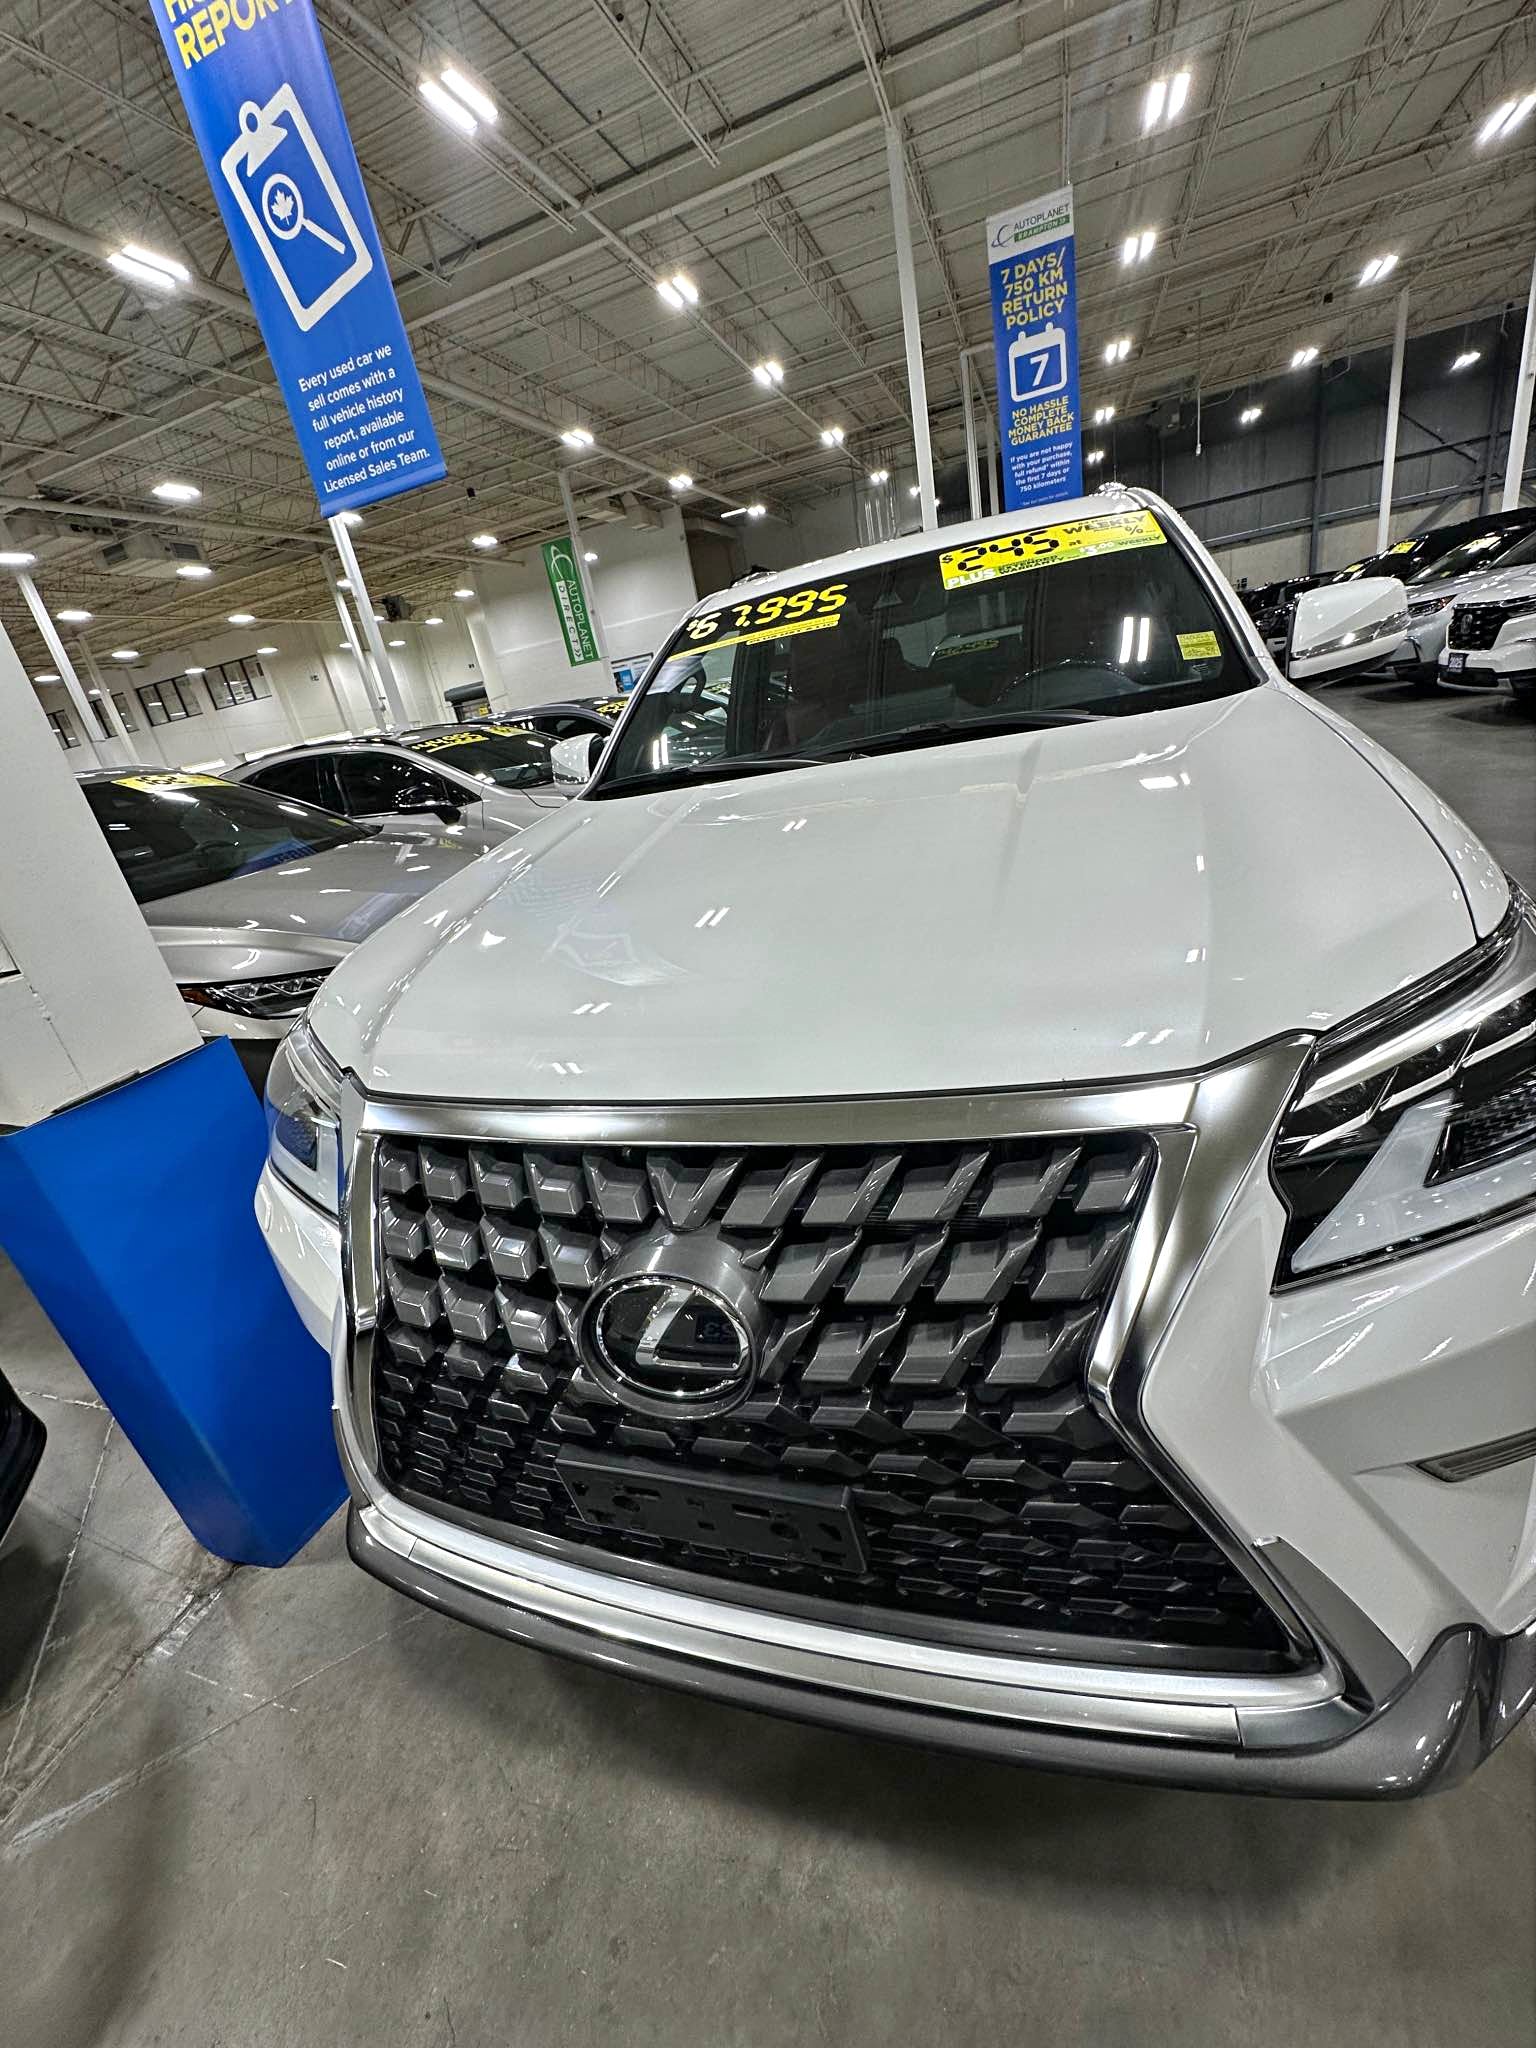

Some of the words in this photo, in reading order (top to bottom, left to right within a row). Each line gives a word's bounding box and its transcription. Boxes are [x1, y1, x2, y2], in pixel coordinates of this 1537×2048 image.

[1014, 202, 1070, 230] AUTOPLANET
[1000, 268, 1010, 284] 7
[1014, 246, 1066, 280] DAYS/
[1001, 281, 1068, 316] RETURN
[1004, 277, 1034, 299] 750
[1038, 266, 1063, 287] KM
[1006, 298, 1065, 330] POLICY
[298, 371, 327, 392] Every
[329, 357, 355, 380] used
[356, 352, 373, 367] car
[375, 344, 392, 360] we
[1030, 353, 1049, 387] 7
[308, 394, 327, 412] sell
[327, 382, 362, 404] comes
[361, 371, 387, 389] with
[388, 367, 396, 379] a
[312, 413, 330, 432] full
[330, 402, 366, 425] vehicle
[366, 388, 404, 411] history
[1012, 407, 1027, 420] NO
[1030, 395, 1069, 413] HASSLE
[1014, 405, 1068, 428] COMPLETE
[323, 428, 359, 450] report,
[360, 410, 405, 437] available
[1008, 420, 1046, 439] MONEY
[1046, 411, 1075, 428] BACK
[1011, 423, 1073, 446] GUARANTEE
[326, 450, 357, 471] online
[358, 446, 370, 459] or
[370, 436, 397, 455] from
[398, 429, 415, 444] our
[1012, 461, 1026, 471] with
[1026, 458, 1041, 469] your
[1016, 453, 1029, 464] you
[1029, 450, 1040, 459] are
[1040, 446, 1052, 456] not
[1053, 441, 1073, 453] happy
[323, 468, 367, 493] Licensed
[368, 457, 397, 477] Sales
[398, 447, 431, 466] Team.
[1014, 468, 1025, 478] full
[1050, 458, 1070, 470] within
[1015, 476, 1026, 487] the
[1027, 474, 1040, 483] first
[1062, 466, 1071, 474] or
[1020, 484, 1032, 493] 750
[1033, 476, 1067, 490] kilometers
[946, 567, 996, 588] PLUS
[566, 579, 594, 658] AUTOPLANET
